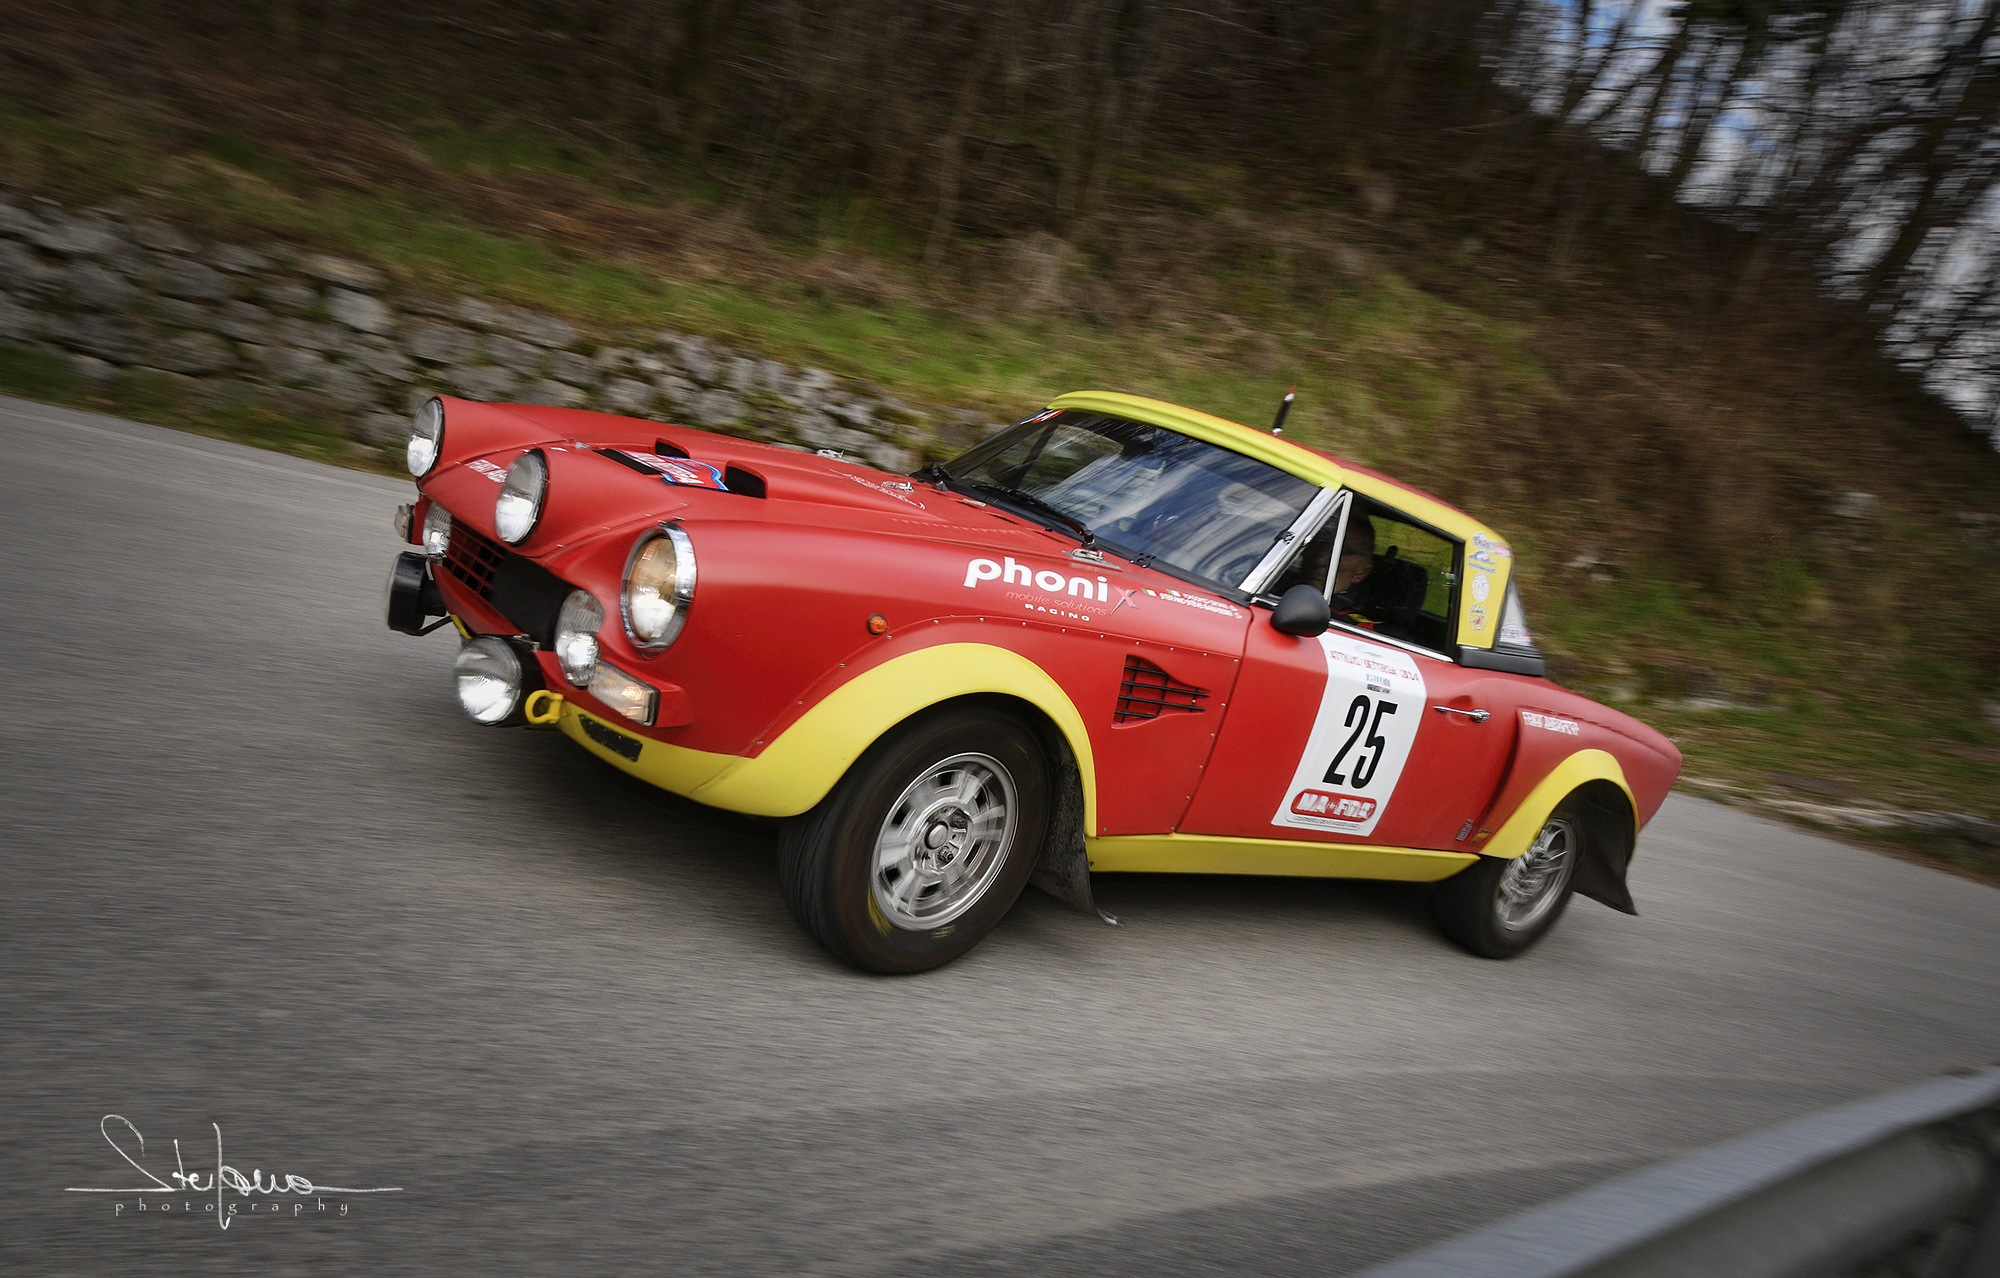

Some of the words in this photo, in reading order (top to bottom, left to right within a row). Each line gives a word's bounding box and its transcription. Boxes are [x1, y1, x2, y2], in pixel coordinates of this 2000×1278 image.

[1005, 591, 1051, 605] mobile
[1053, 599, 1107, 616] solutions
[1025, 603, 1090, 622] RACING
[1322, 695, 1399, 789] 25
